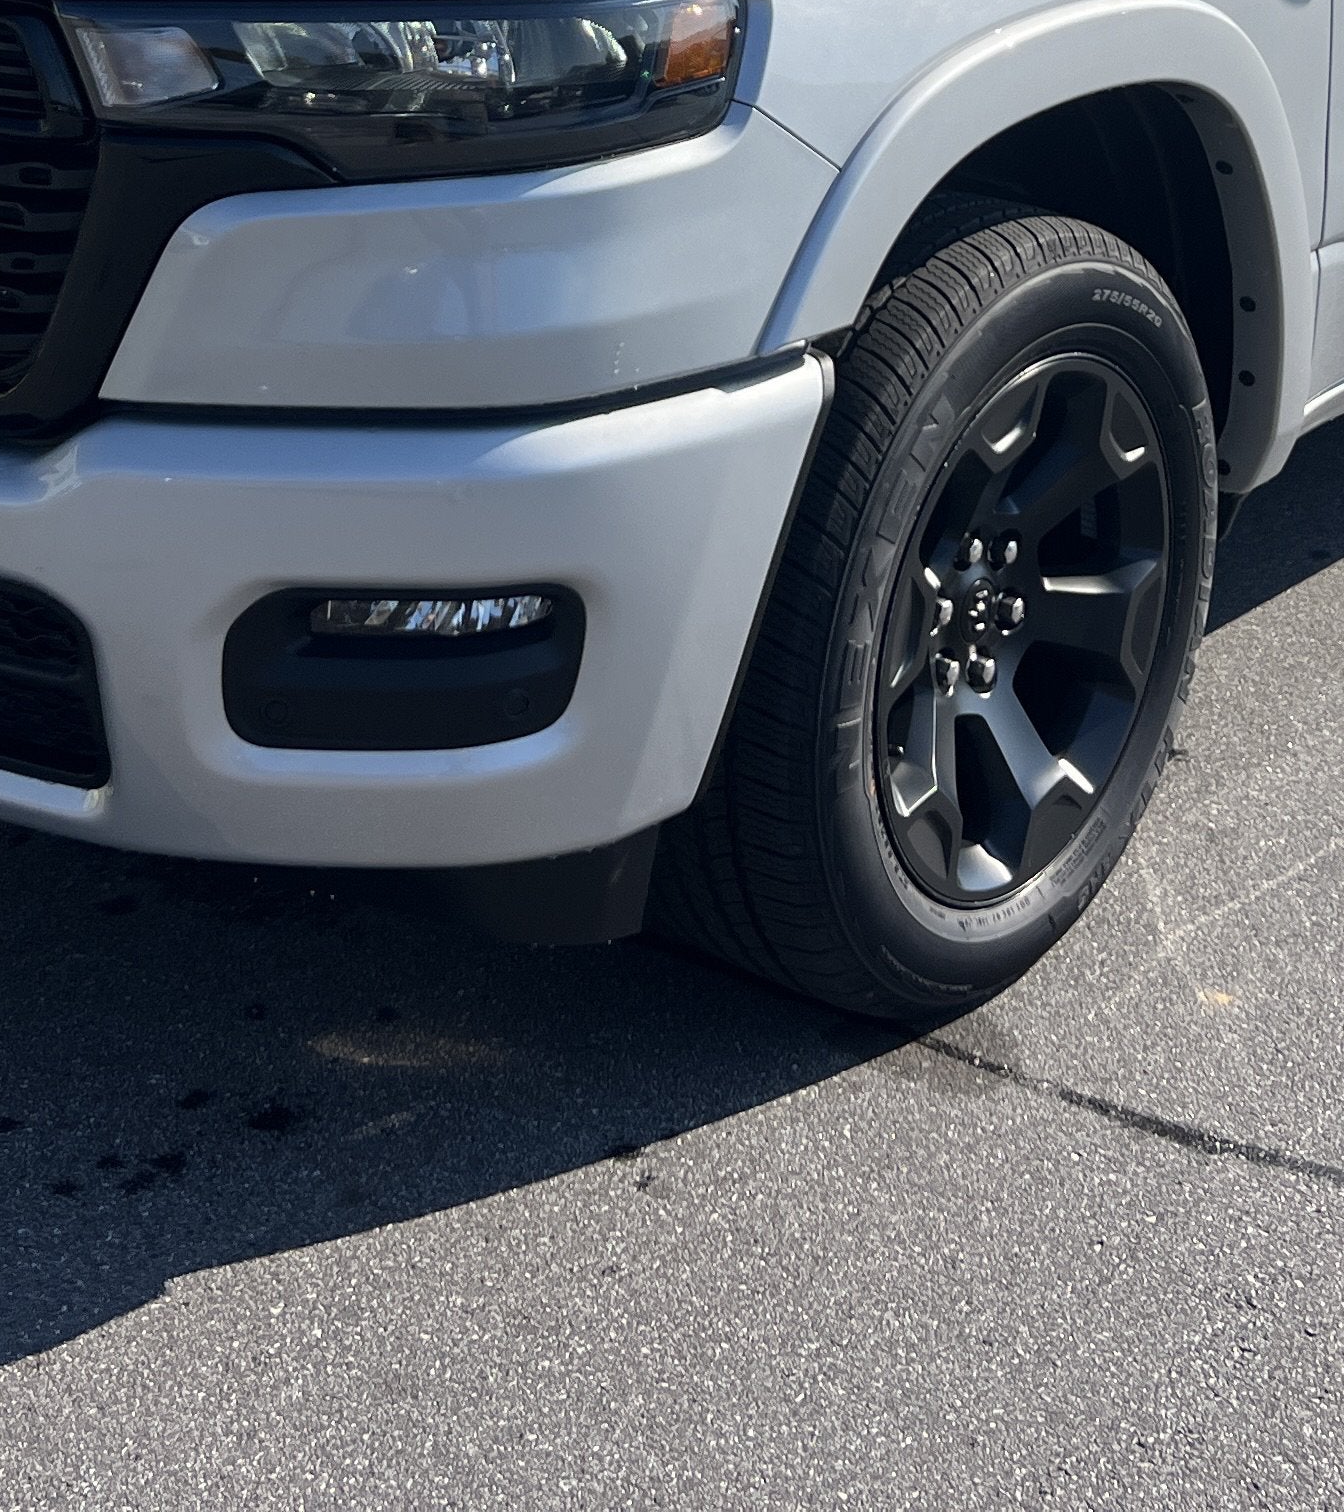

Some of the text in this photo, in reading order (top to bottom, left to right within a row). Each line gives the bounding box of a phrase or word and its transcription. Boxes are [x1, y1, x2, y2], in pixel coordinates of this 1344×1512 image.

[1091, 288, 1163, 328] 275/55R20
[830, 390, 955, 794] NEXEN
[1177, 399, 1220, 705] ROADIAN
